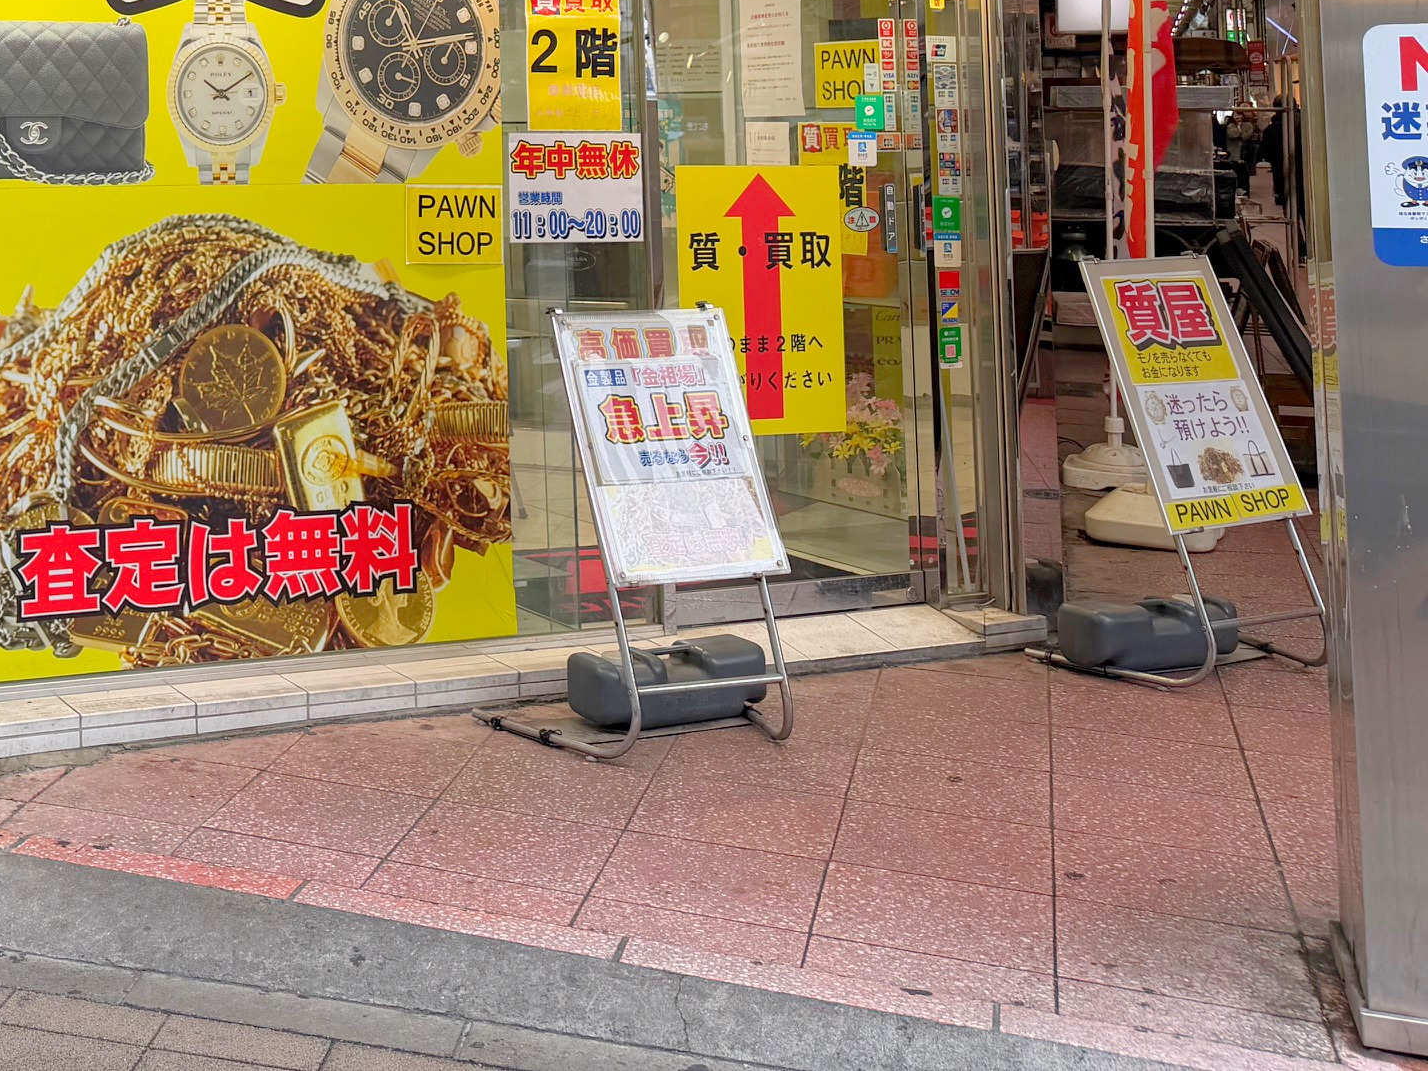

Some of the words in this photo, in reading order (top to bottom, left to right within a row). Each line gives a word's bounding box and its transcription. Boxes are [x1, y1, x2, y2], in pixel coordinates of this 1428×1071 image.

[531, 28, 618, 78] 2階
[821, 48, 875, 70] PAWN
[1381, 102, 1428, 141] 迷
[511, 140, 639, 179] 年中無休
[418, 195, 496, 219] PAWN
[518, 191, 563, 205] 営業時間
[418, 231, 494, 256] SHOP
[1115, 280, 1219, 346] 質屋
[1136, 350, 1212, 364] モノを売らなくても
[586, 369, 626, 387] 金製品
[1142, 366, 1200, 379] お金になります
[1165, 390, 1228, 415] 迷ったら
[599, 391, 729, 443] 急上昇
[1175, 498, 1233, 523] PAWN
[1244, 488, 1290, 512] SHOP
[18, 502, 419, 618] 査定は無料
